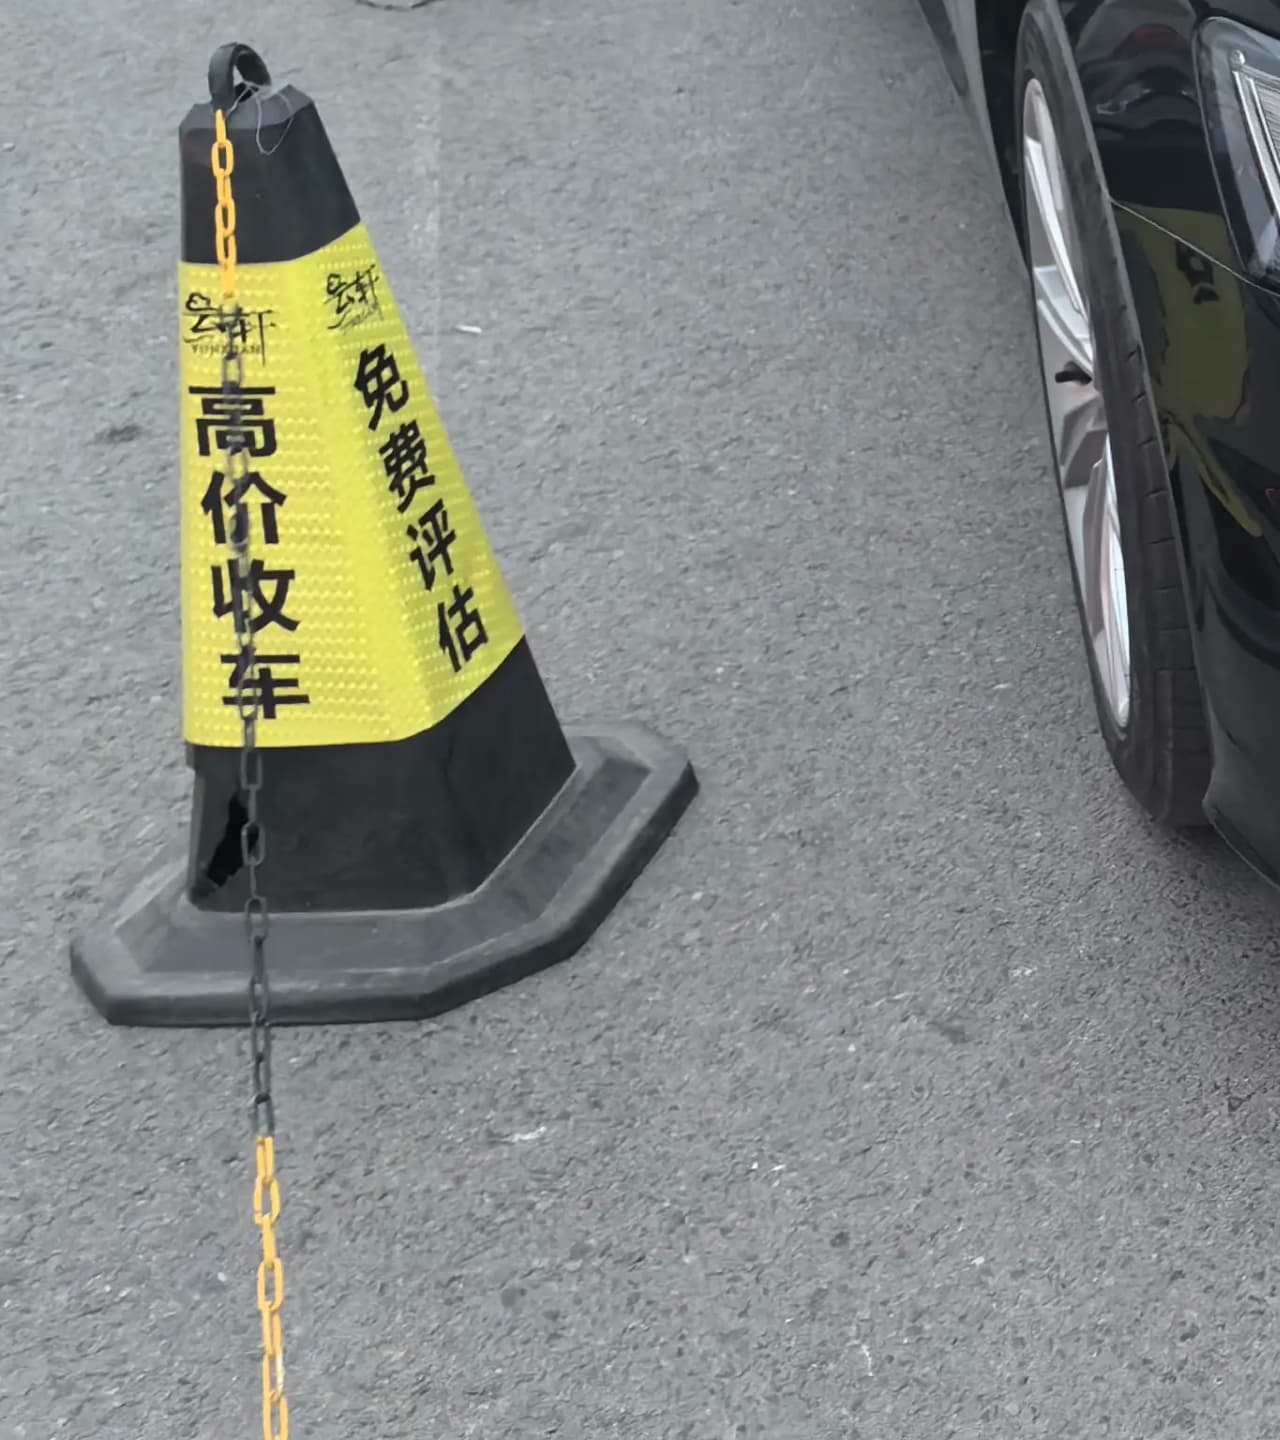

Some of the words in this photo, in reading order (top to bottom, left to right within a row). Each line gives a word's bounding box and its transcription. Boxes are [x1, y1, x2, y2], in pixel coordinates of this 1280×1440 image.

[188, 385, 310, 720] 高价收车
[353, 343, 490, 673] 免费评估
